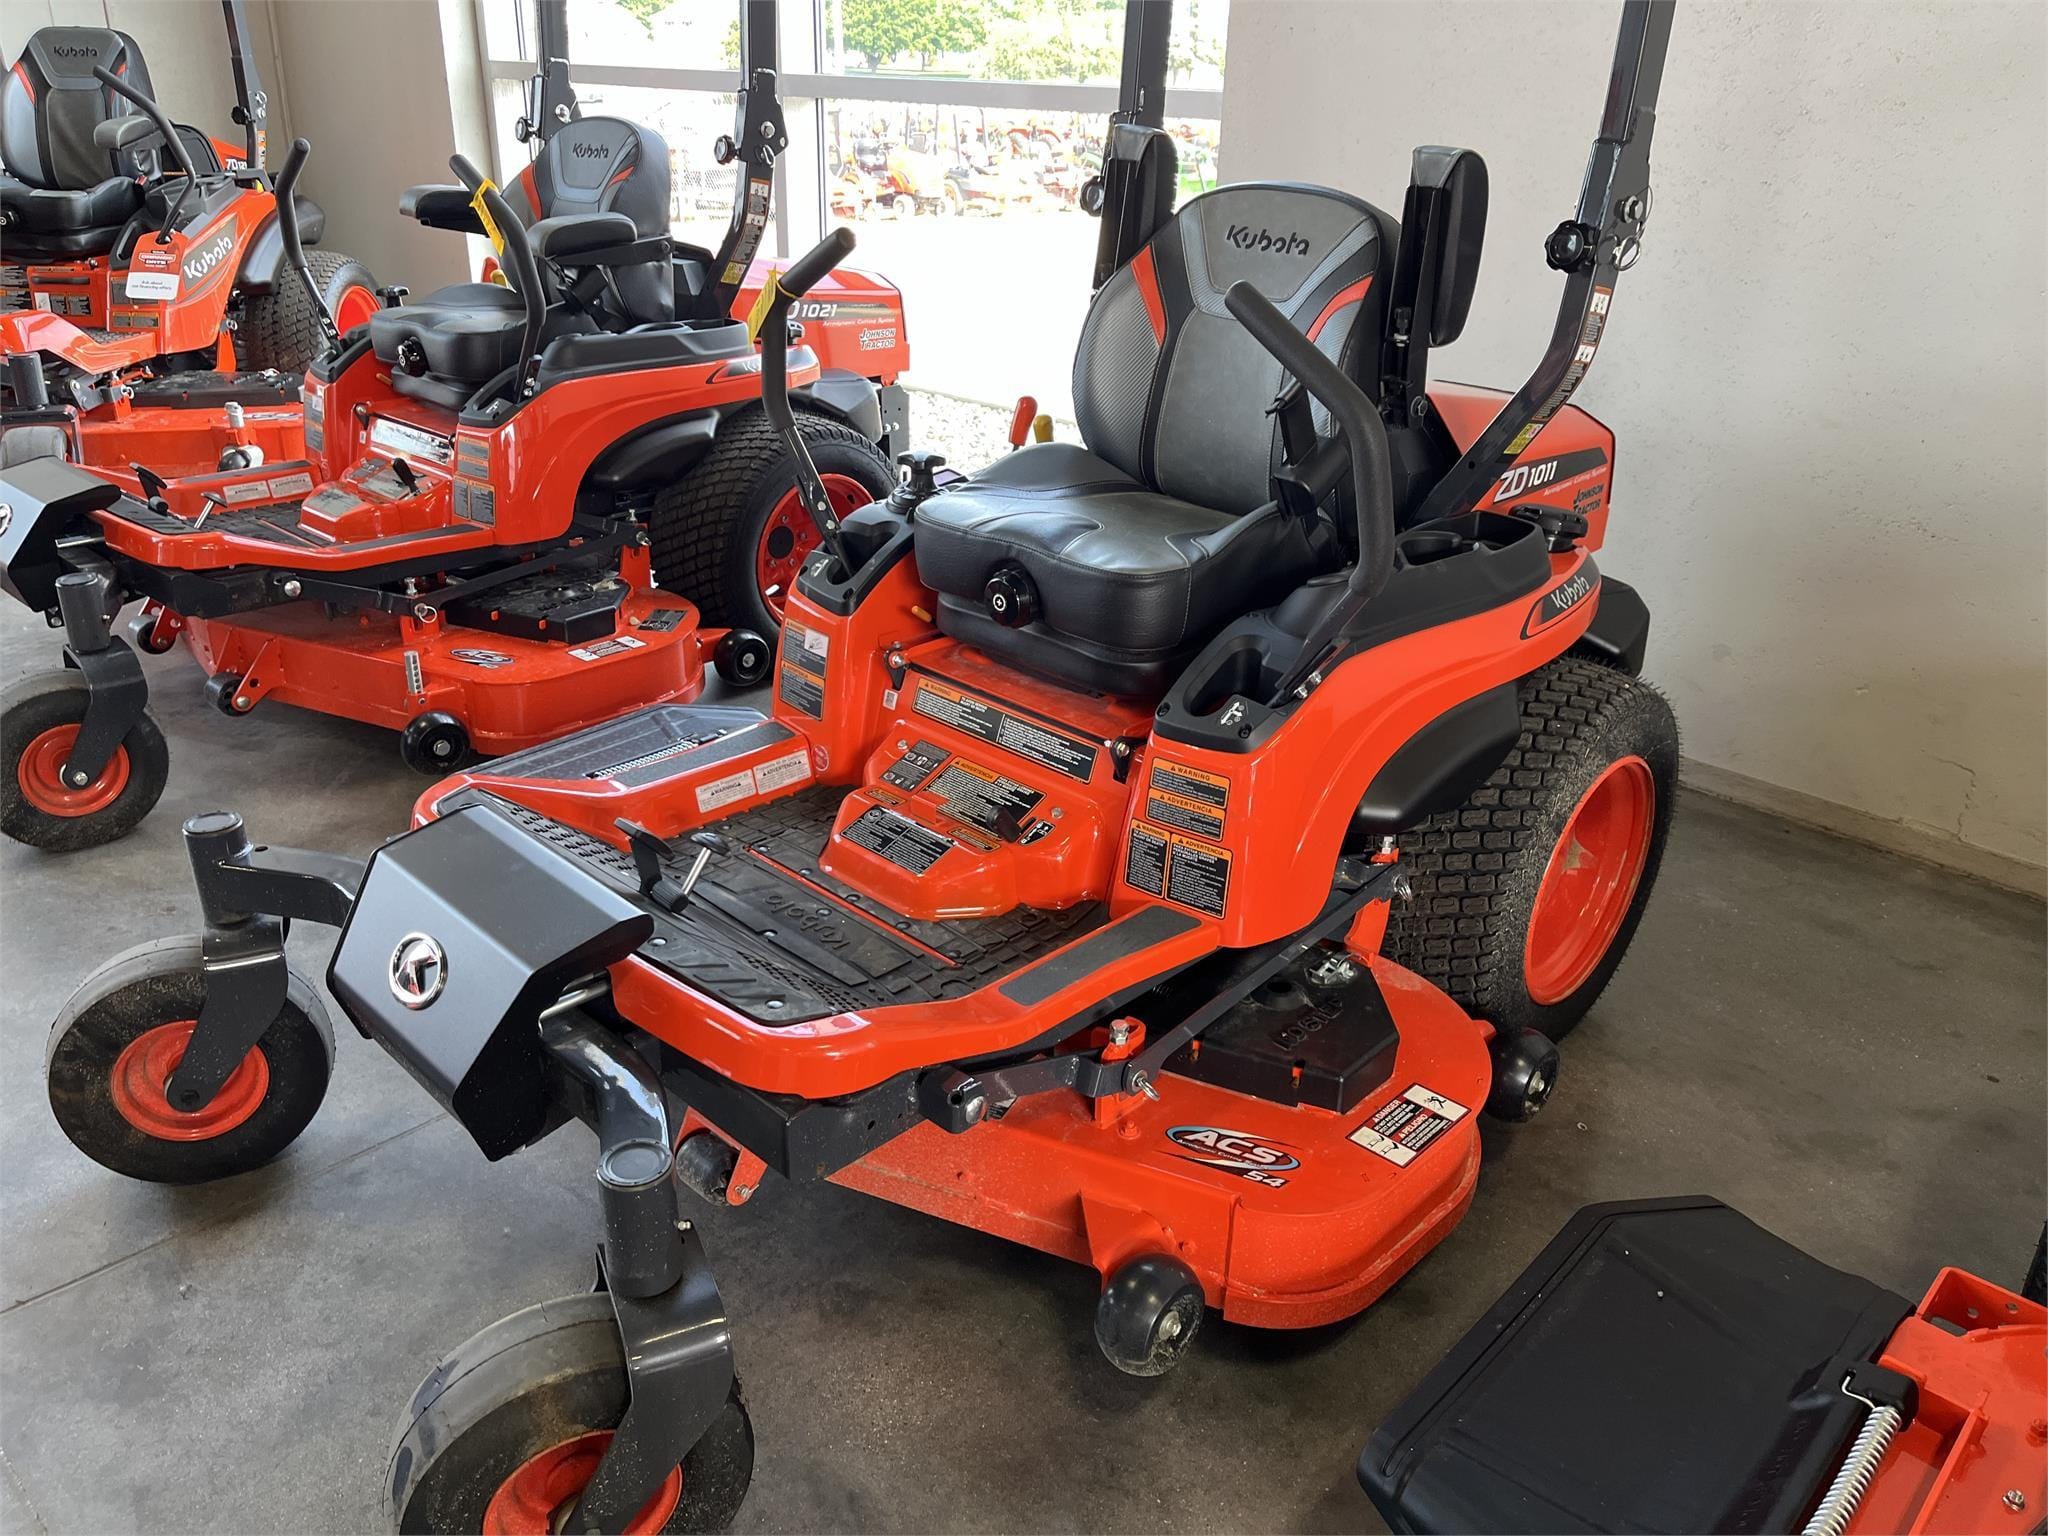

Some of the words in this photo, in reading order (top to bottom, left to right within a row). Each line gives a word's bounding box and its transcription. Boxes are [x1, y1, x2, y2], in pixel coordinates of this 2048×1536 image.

[53, 46, 98, 57] Kubota
[572, 142, 609, 159] Kubota
[1226, 225, 1310, 256] Kubota
[183, 236, 233, 279] Kubota
[860, 328, 896, 340] JOHNSON
[860, 339, 896, 351] TRACTOR
[1550, 574, 1590, 609] Kubota
[960, 763, 993, 780] ADVERTENCIA
[1177, 766, 1210, 781] WARNING
[1167, 794, 1213, 814] ADVERTENCIA
[1141, 825, 1165, 838] WARNING
[1185, 839, 1224, 856] ADVERTENCIA
[764, 895, 851, 951] Kubota
[1375, 1099, 1402, 1119] DANGER
[1401, 1113, 1428, 1135] PELIGRO
[1183, 1130, 1285, 1164] ACS
[1242, 1170, 1286, 1187] 54
